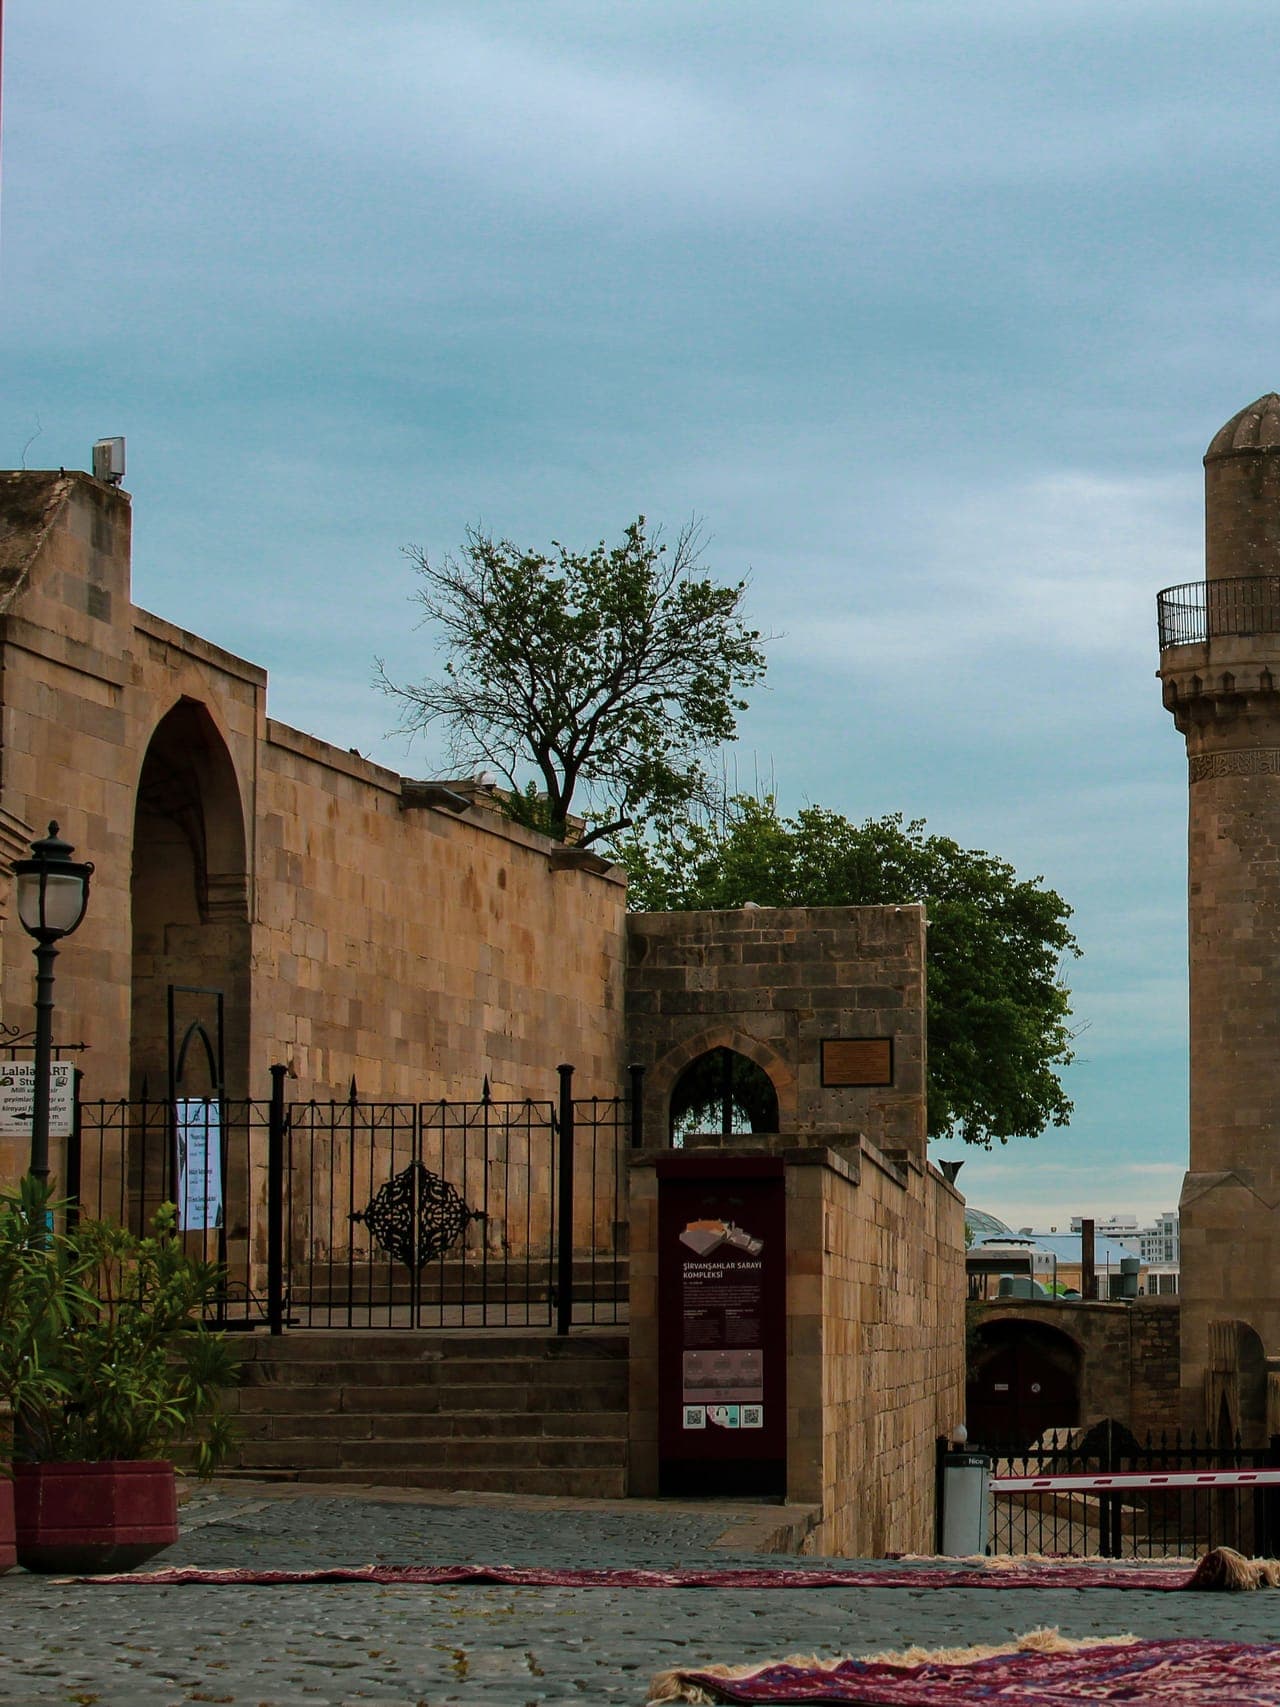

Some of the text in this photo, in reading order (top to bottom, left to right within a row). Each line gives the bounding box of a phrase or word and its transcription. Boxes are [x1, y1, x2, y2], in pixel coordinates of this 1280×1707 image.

[50, 1066, 69, 1076] RT
[19, 1078, 36, 1086] Stu
[683, 1270, 723, 1279] KOMPLEKSİ
[968, 1457, 984, 1465] Nice
